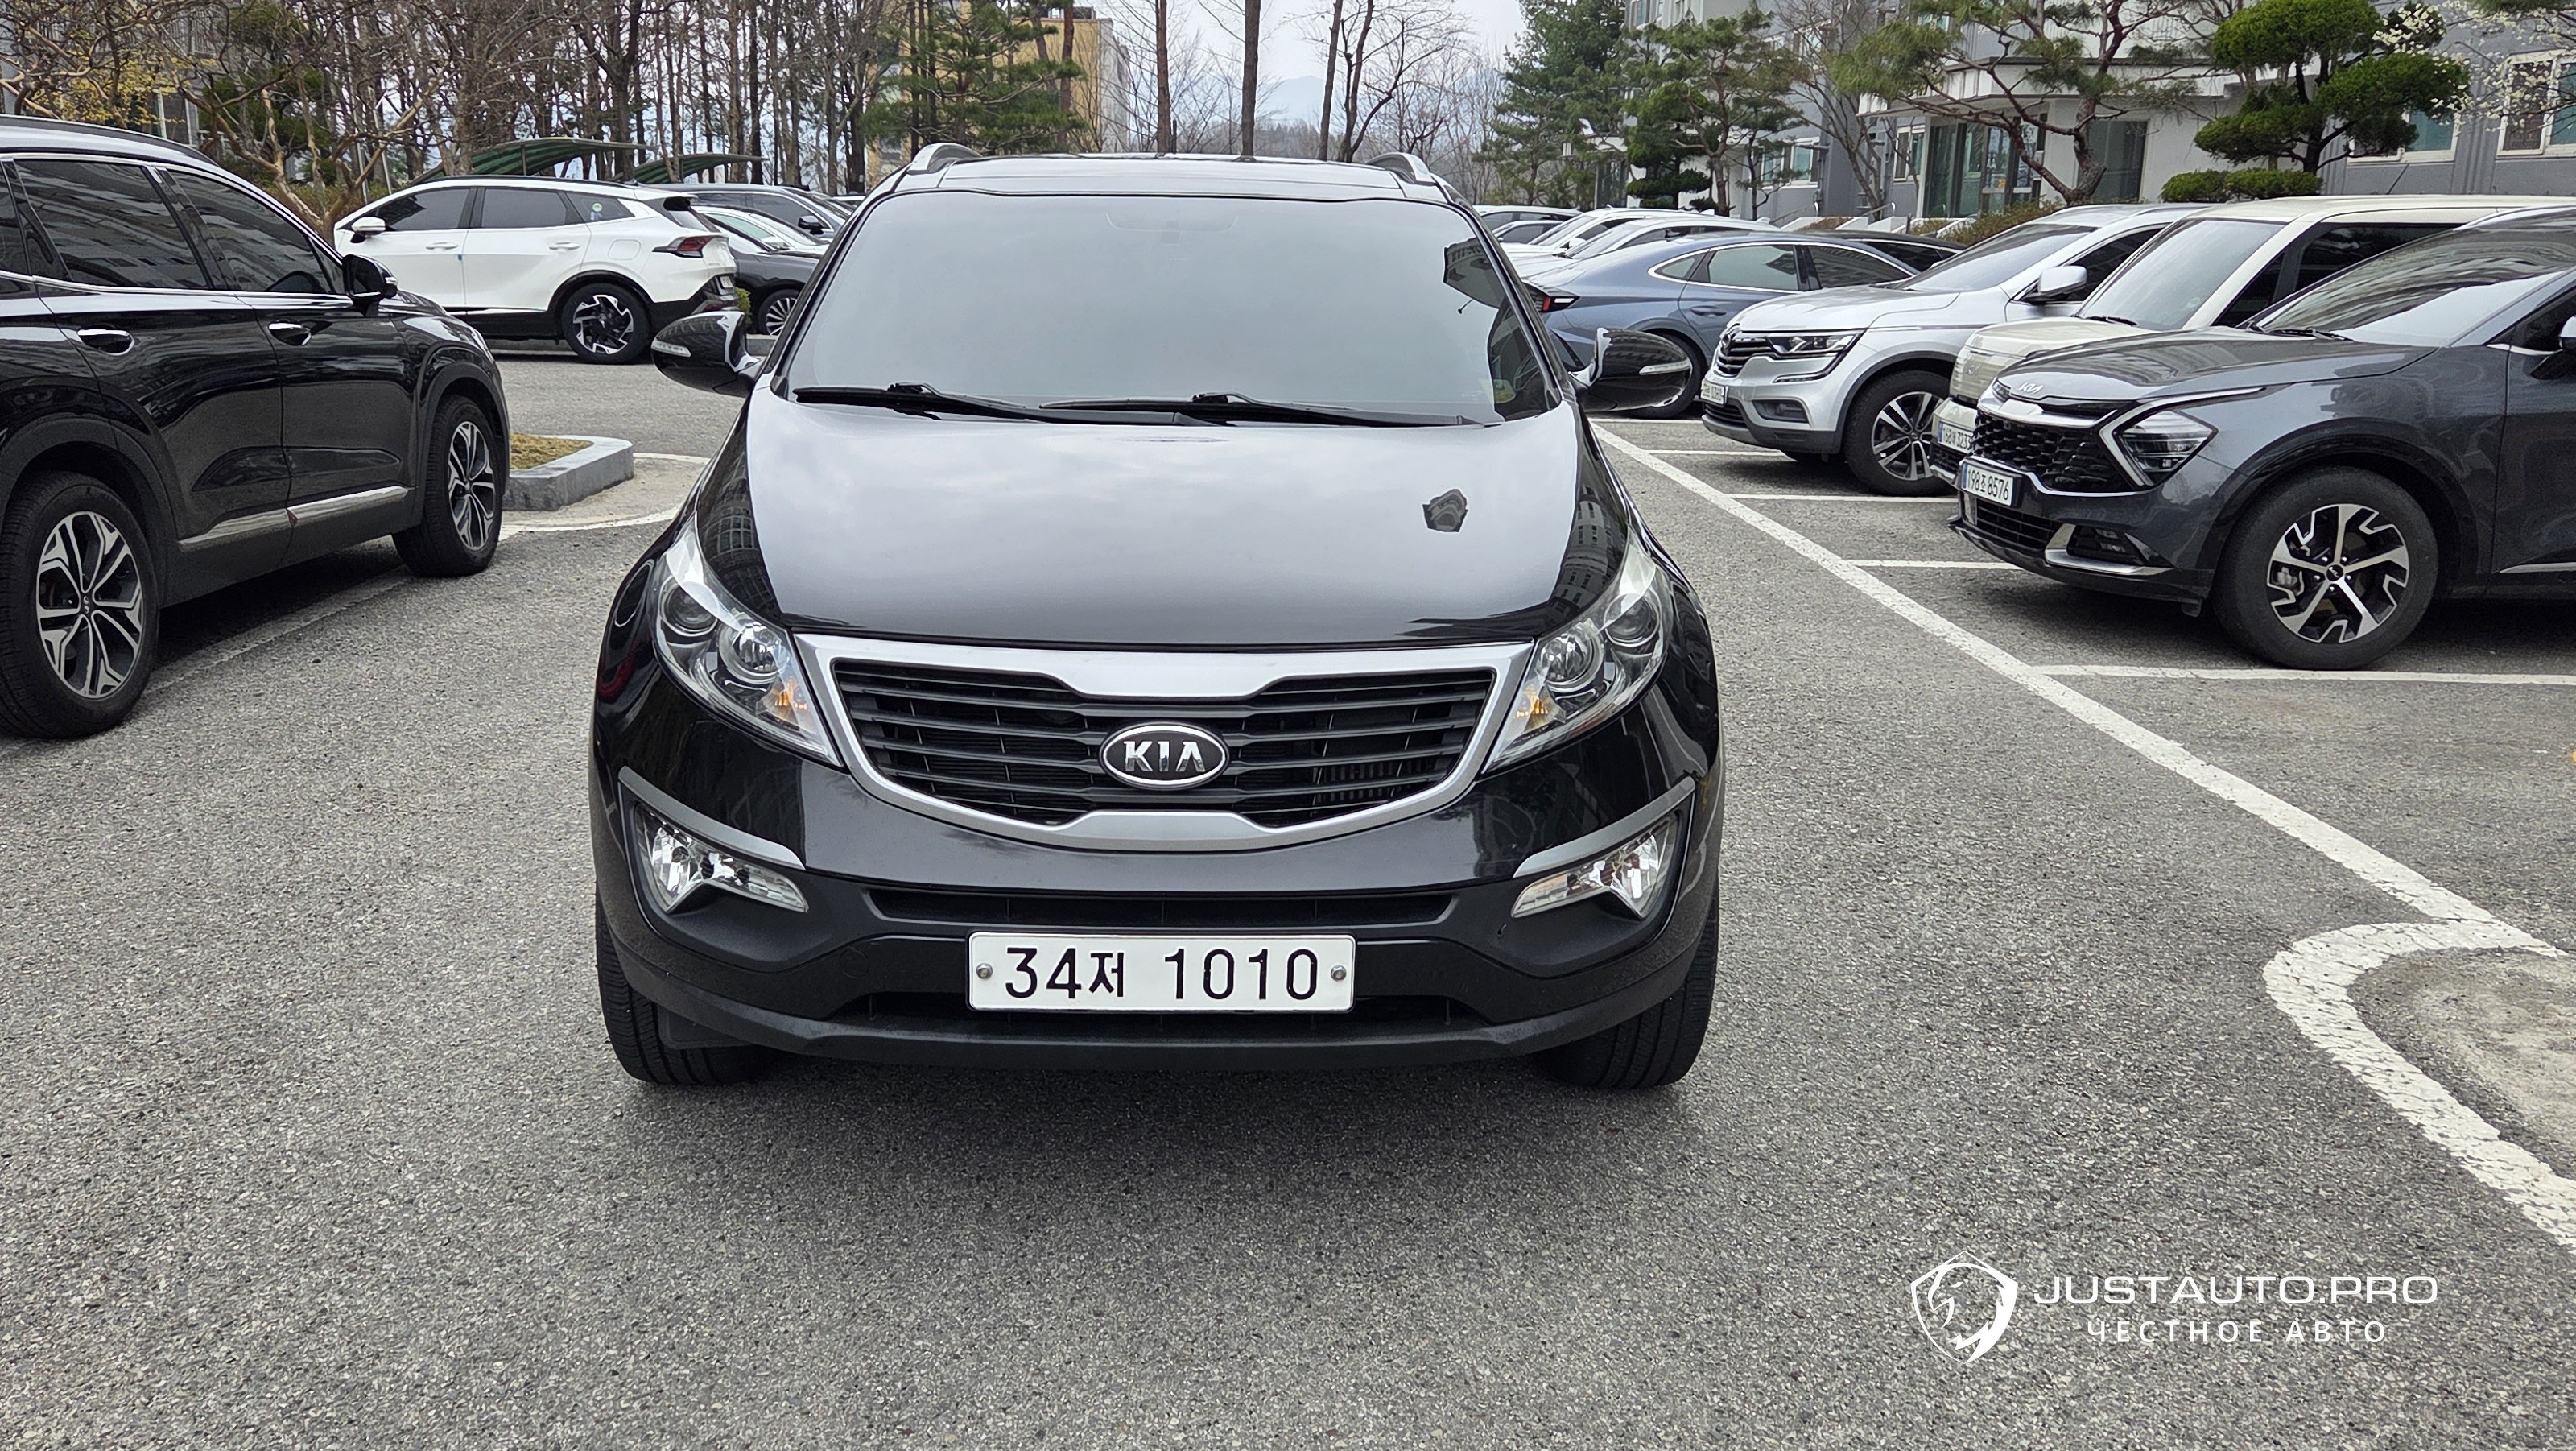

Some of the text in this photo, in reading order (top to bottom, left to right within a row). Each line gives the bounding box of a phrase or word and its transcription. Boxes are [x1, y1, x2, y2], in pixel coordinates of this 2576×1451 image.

[1988, 476, 2008, 500] 8576
[1123, 740, 1206, 772] KIA
[1005, 947, 1318, 1001] 34저 1010
